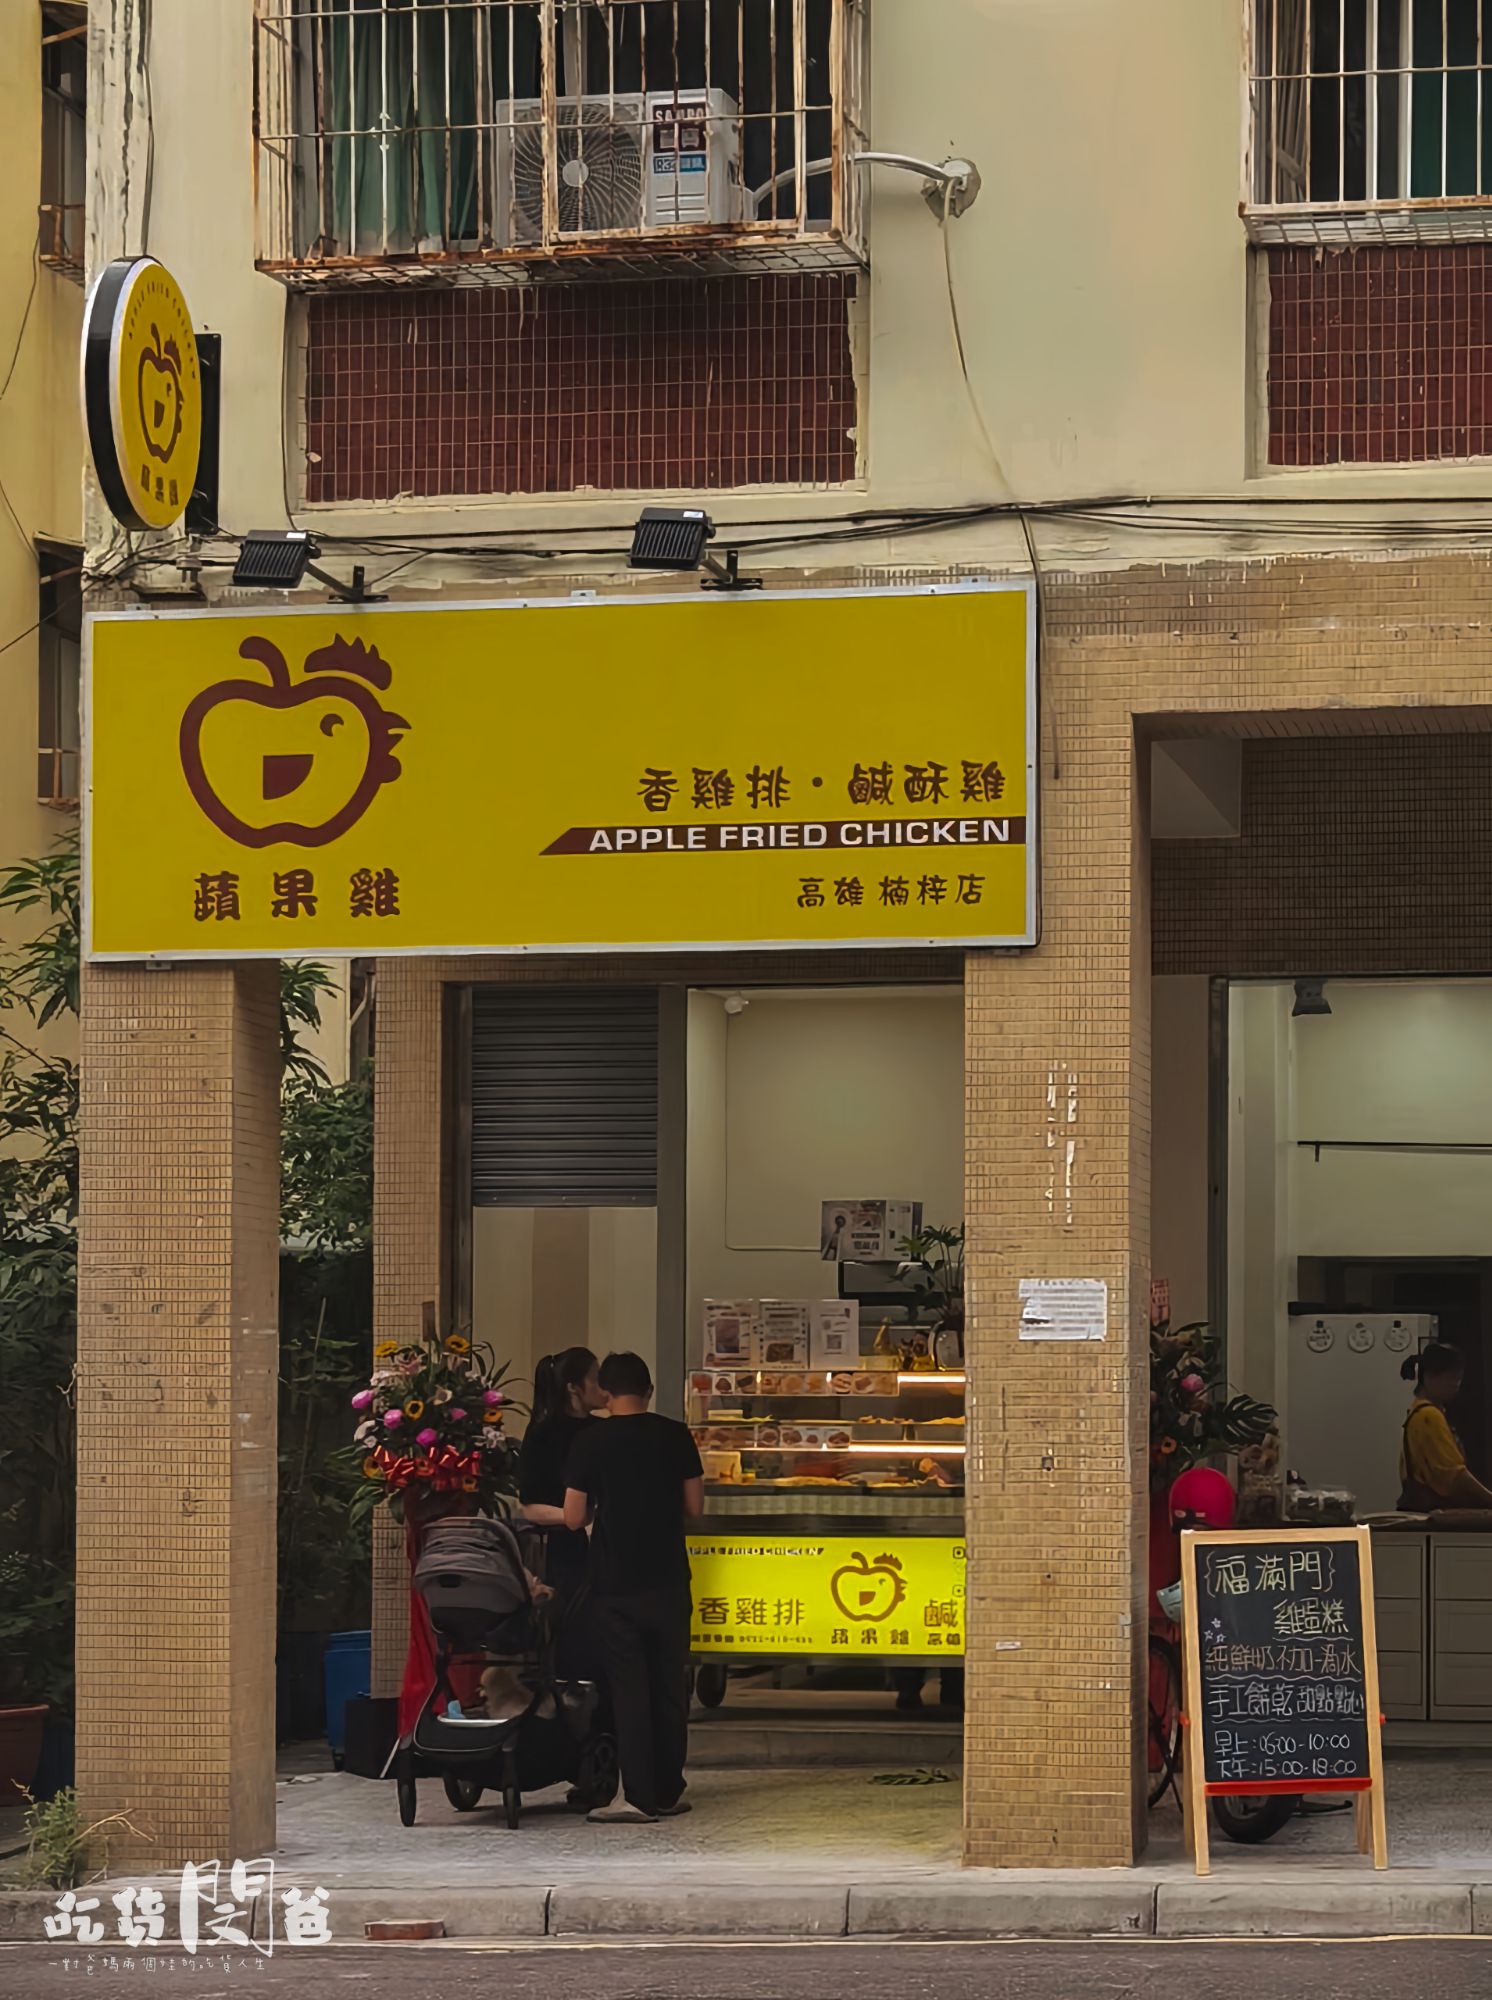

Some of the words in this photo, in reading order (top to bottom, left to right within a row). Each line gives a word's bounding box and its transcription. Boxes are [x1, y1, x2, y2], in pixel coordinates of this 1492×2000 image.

[589, 828, 707, 852] APPLE
[719, 824, 828, 848] FRIED
[839, 819, 1011, 845] CHICKEN
[194, 867, 401, 922] 蘋果雞
[698, 1597, 806, 1626] 香雞排
